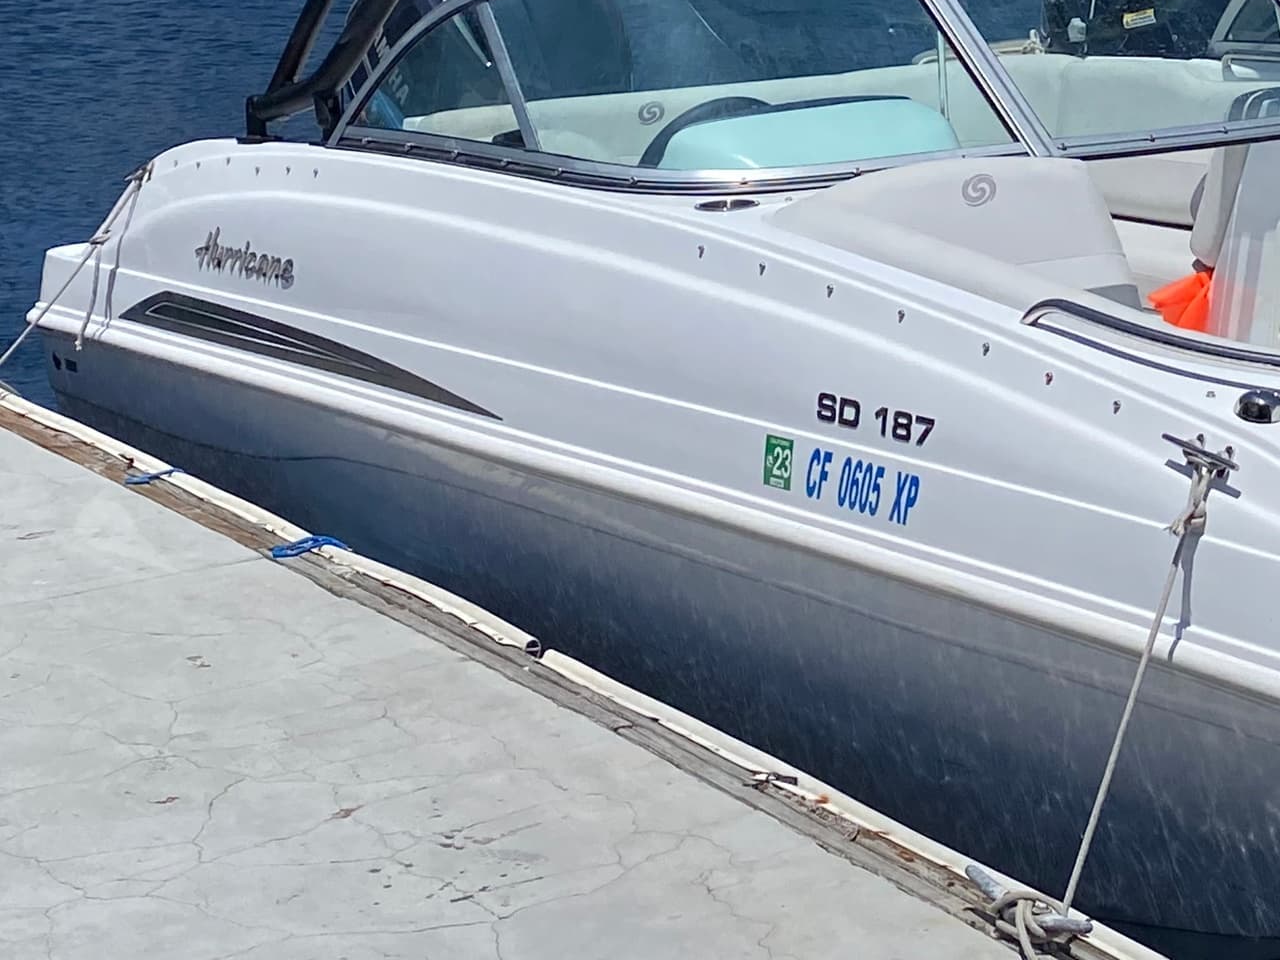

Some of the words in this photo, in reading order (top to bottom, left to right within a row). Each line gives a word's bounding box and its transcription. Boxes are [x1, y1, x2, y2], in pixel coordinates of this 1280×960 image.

[195, 226, 295, 289] Hurricane
[817, 392, 861, 431] SD
[875, 406, 936, 446] 187
[772, 446, 791, 478] 23
[806, 447, 834, 500] CF
[837, 456, 886, 517] 0605
[888, 471, 920, 526] XP
